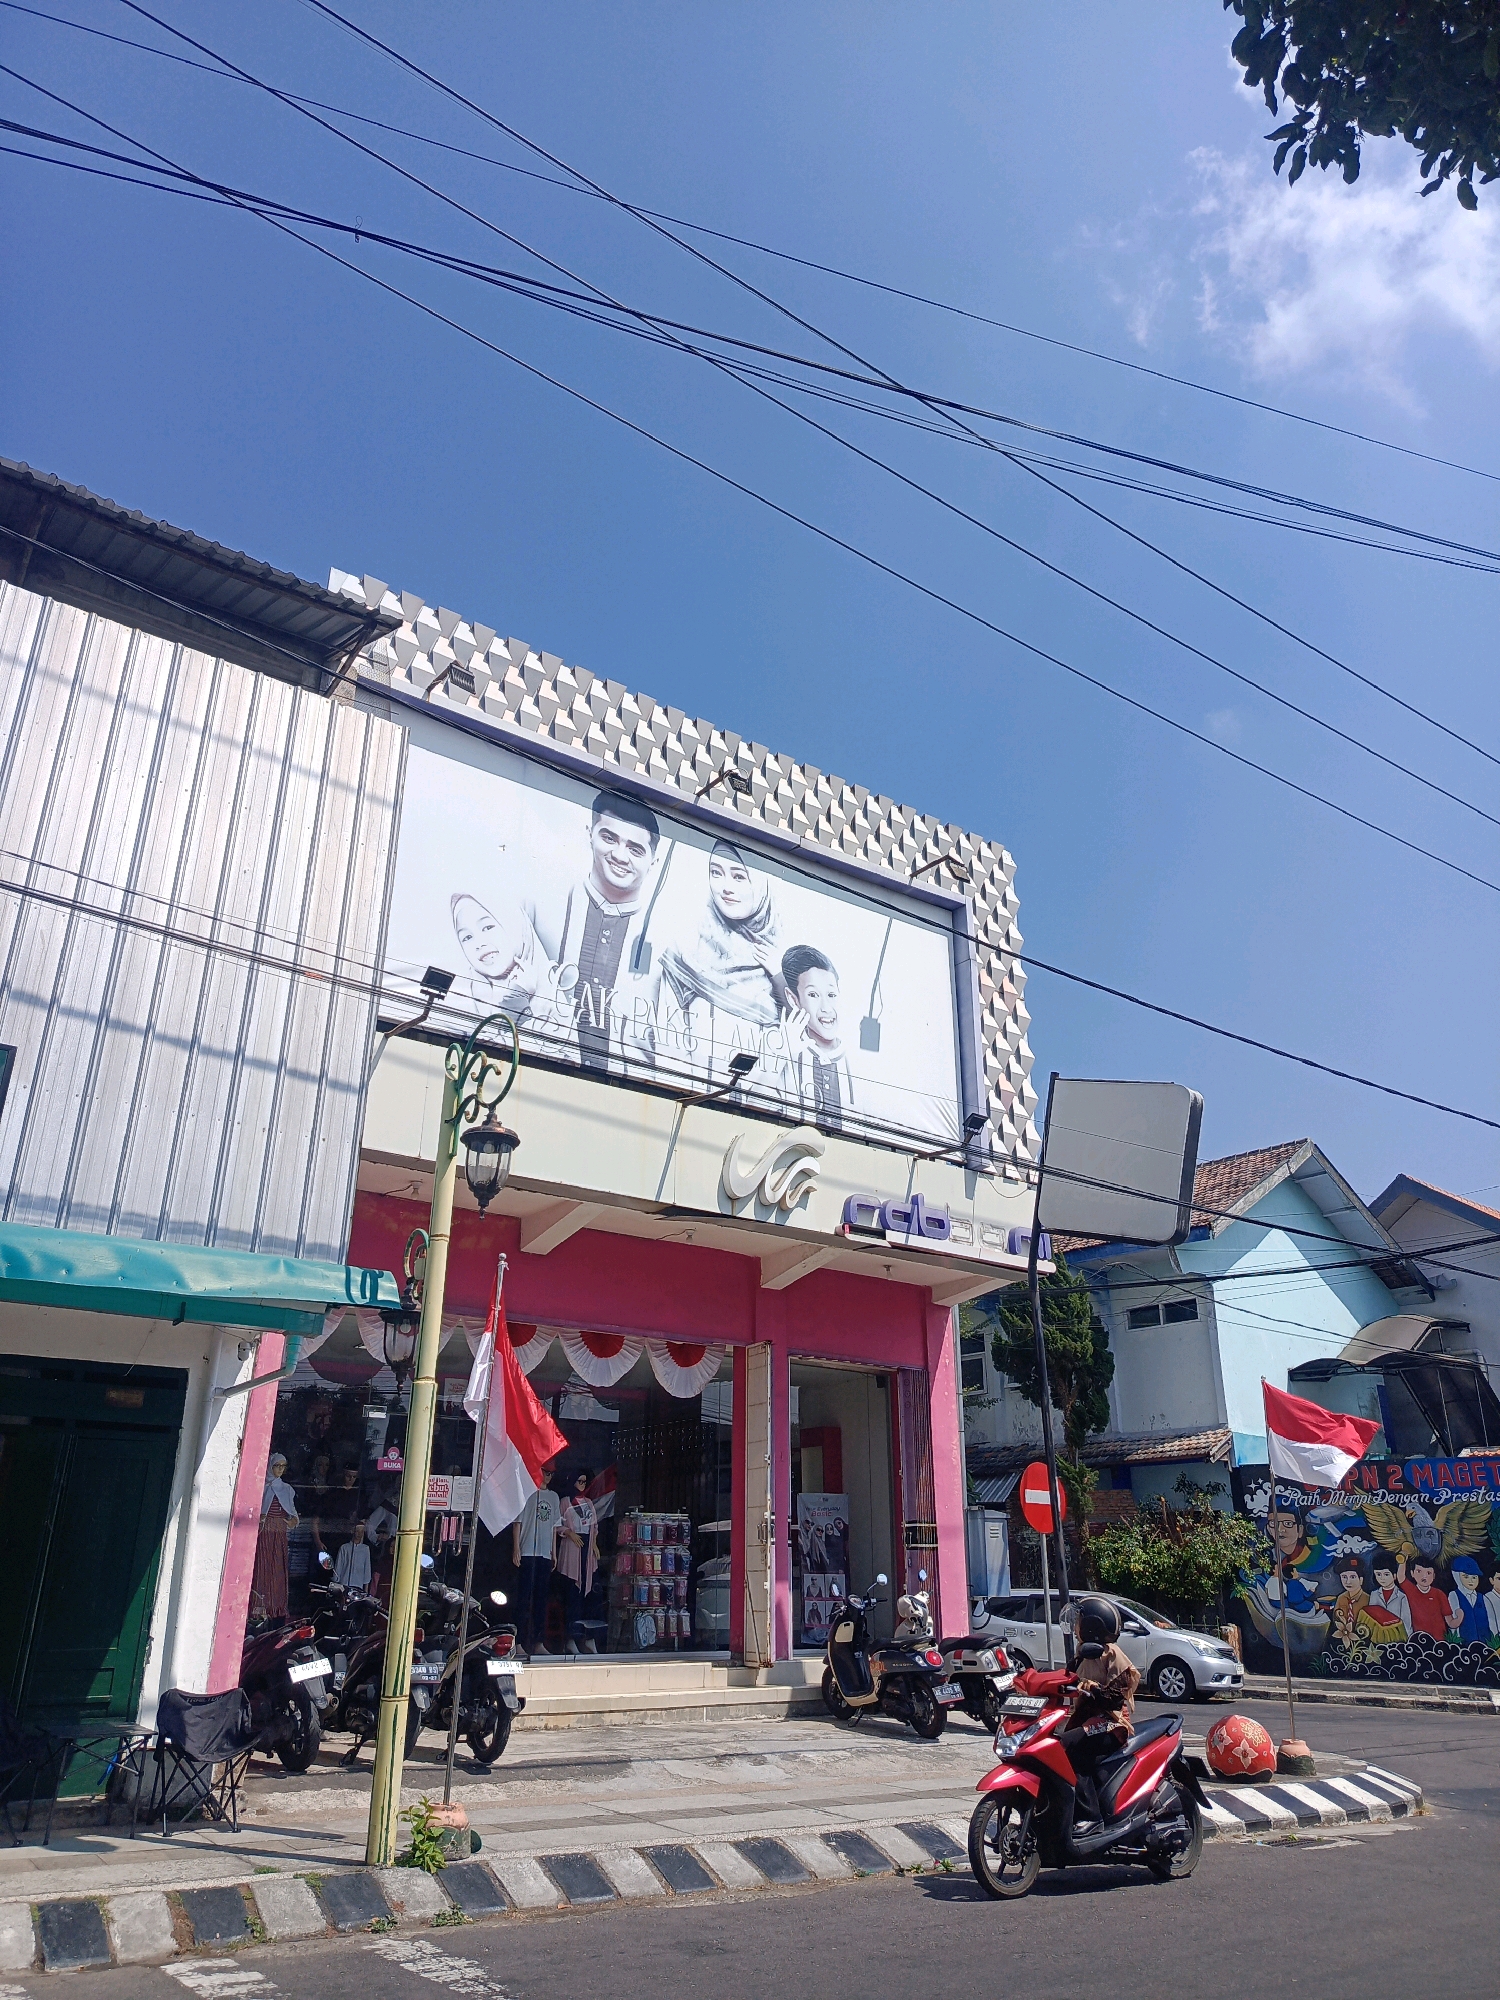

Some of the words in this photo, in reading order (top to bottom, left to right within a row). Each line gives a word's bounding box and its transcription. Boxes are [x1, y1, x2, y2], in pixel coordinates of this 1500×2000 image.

[1386, 1464, 1404, 1490] 2
[1282, 1485, 1321, 1506] Raih
[1321, 1488, 1371, 1508] Mimpi
[1370, 1488, 1430, 1508] Dengan
